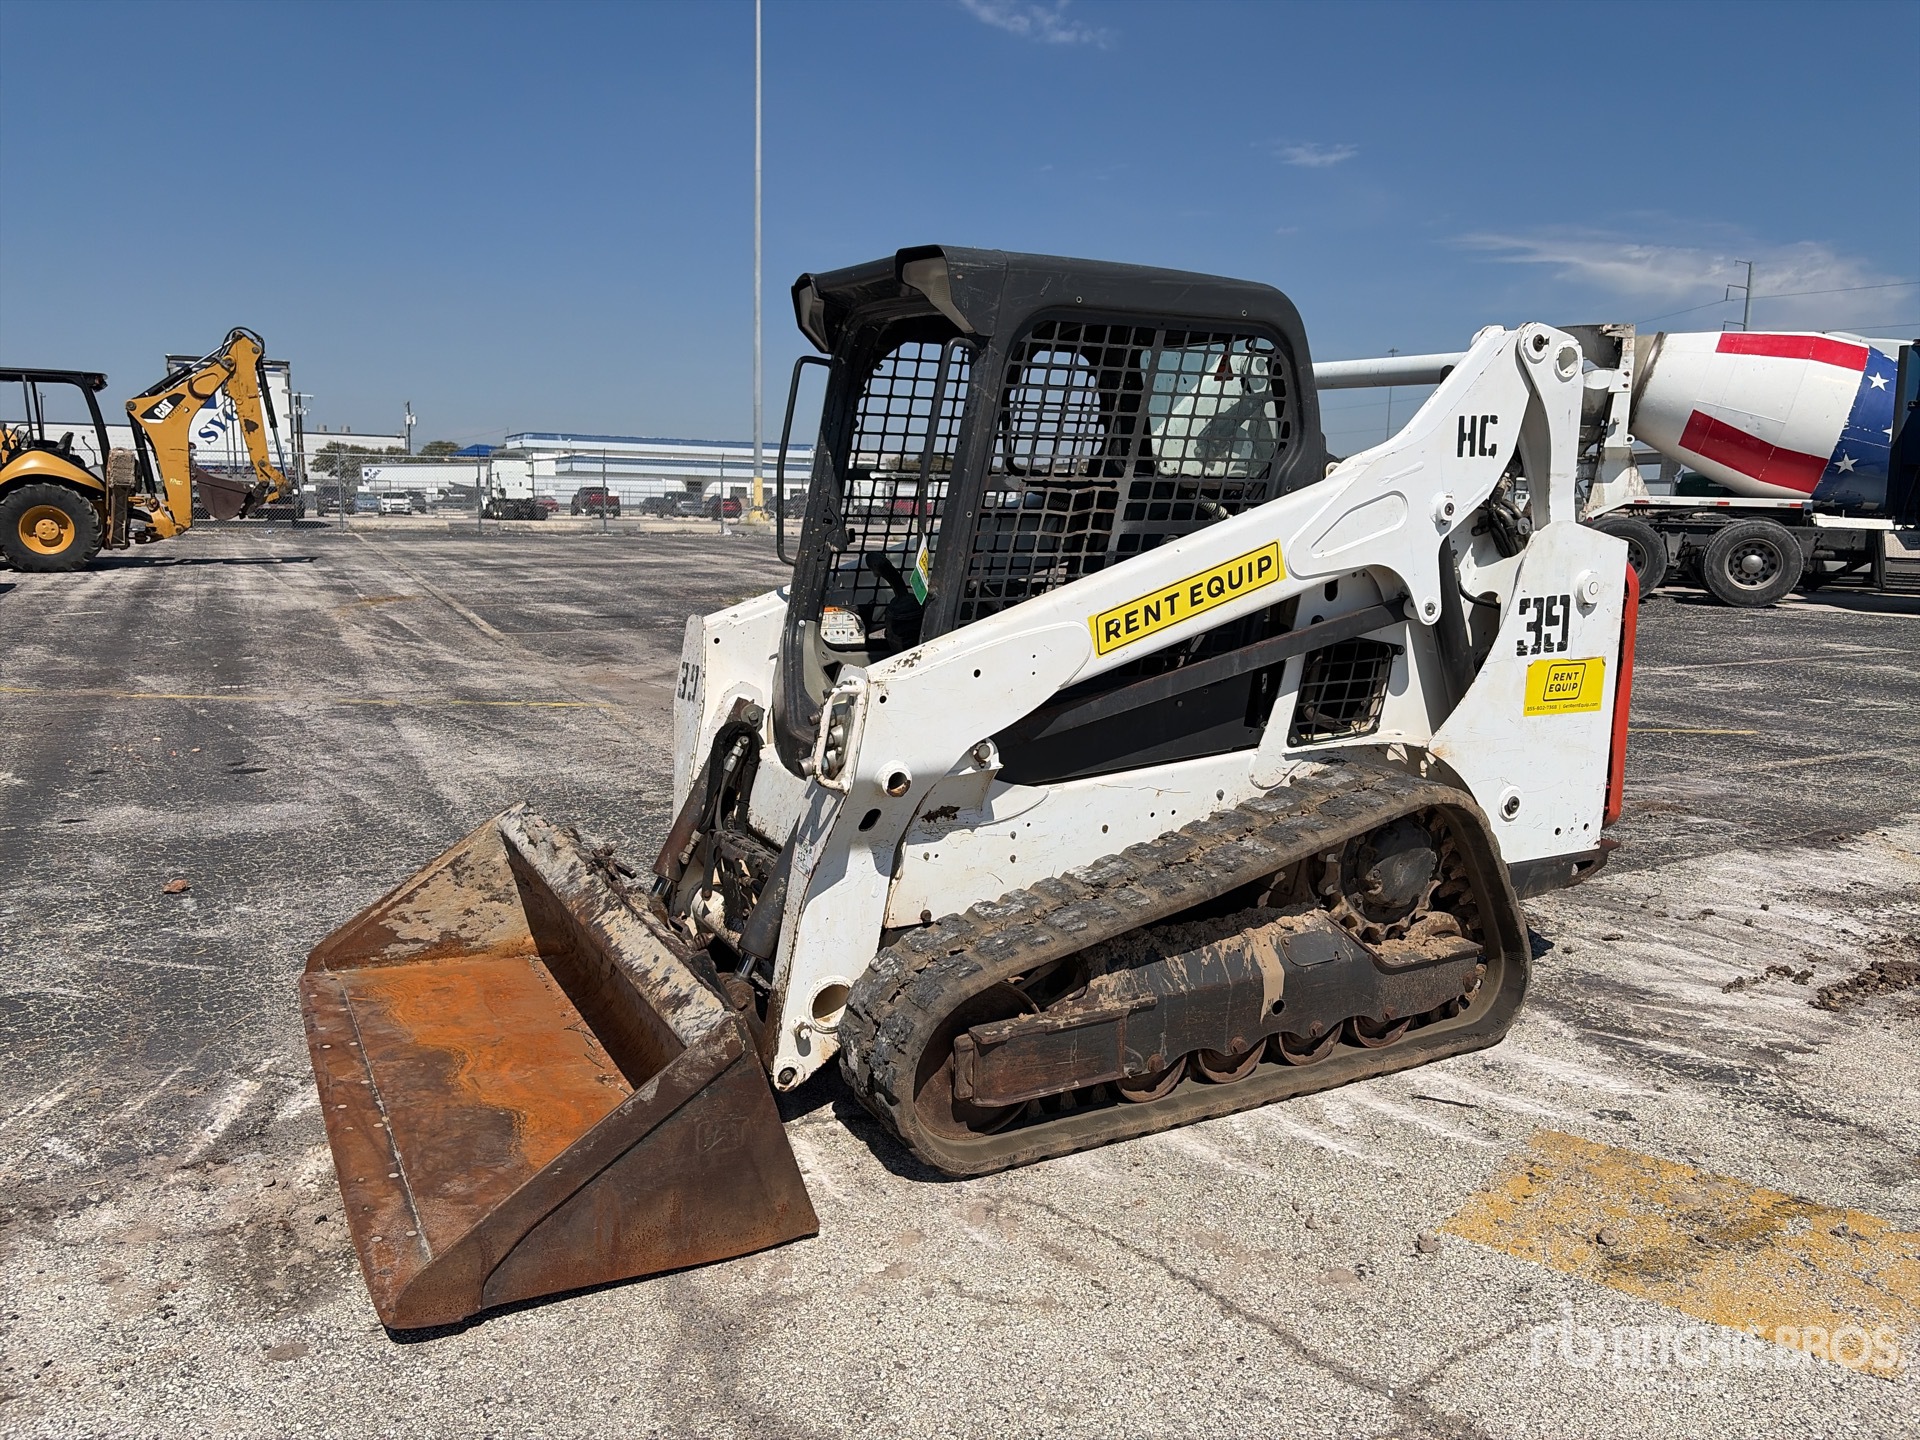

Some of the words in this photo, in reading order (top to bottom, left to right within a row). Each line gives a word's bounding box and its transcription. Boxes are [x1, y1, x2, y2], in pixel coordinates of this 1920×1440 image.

[153, 398, 174, 419] CAT
[1457, 414, 1498, 459] HC
[1104, 592, 1180, 643] RENT
[1190, 555, 1273, 608] EQUIP
[1516, 593, 1571, 657] 39
[1548, 682, 1578, 693] EQUIP
[1552, 671, 1580, 681] RENT
